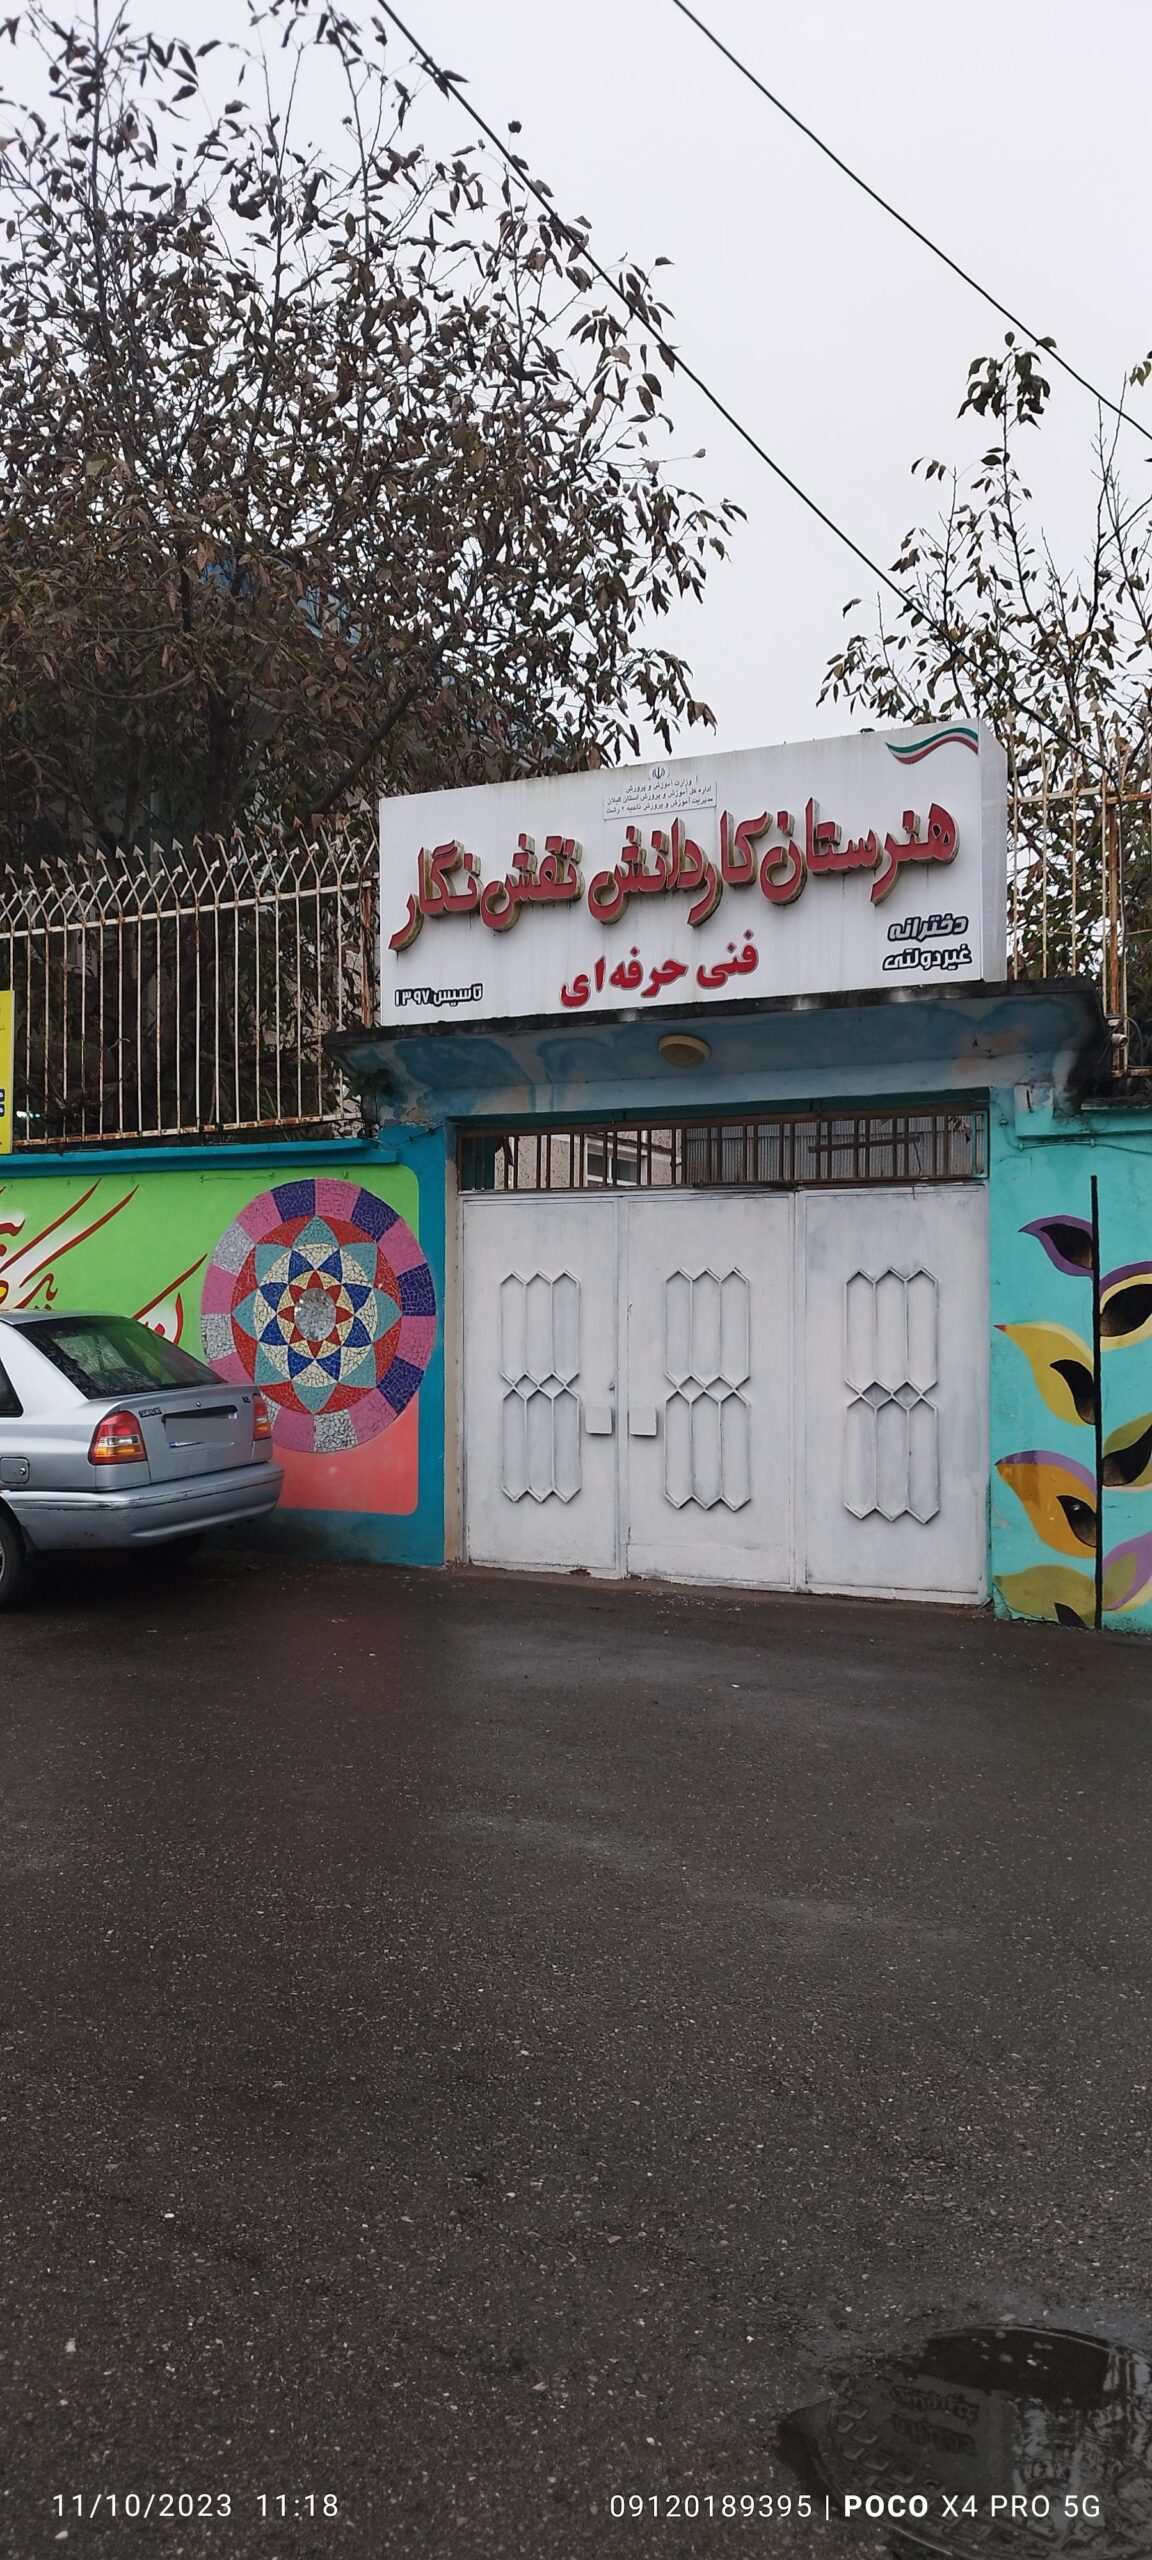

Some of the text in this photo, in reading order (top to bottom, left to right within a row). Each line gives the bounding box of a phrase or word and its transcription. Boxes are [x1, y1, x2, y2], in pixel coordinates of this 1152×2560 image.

[653, 778, 673, 790] آموزش
[674, 778, 692, 787] وزارت
[668, 787, 688, 798] آموزش
[670, 797, 691, 808] آموزش
[388, 797, 961, 951] هنرستان کاردانش نقش نگار
[887, 912, 969, 943] دخترانه
[696, 928, 760, 990] فنی
[395, 983, 483, 1007] تاسیس ۱۳۹۷
